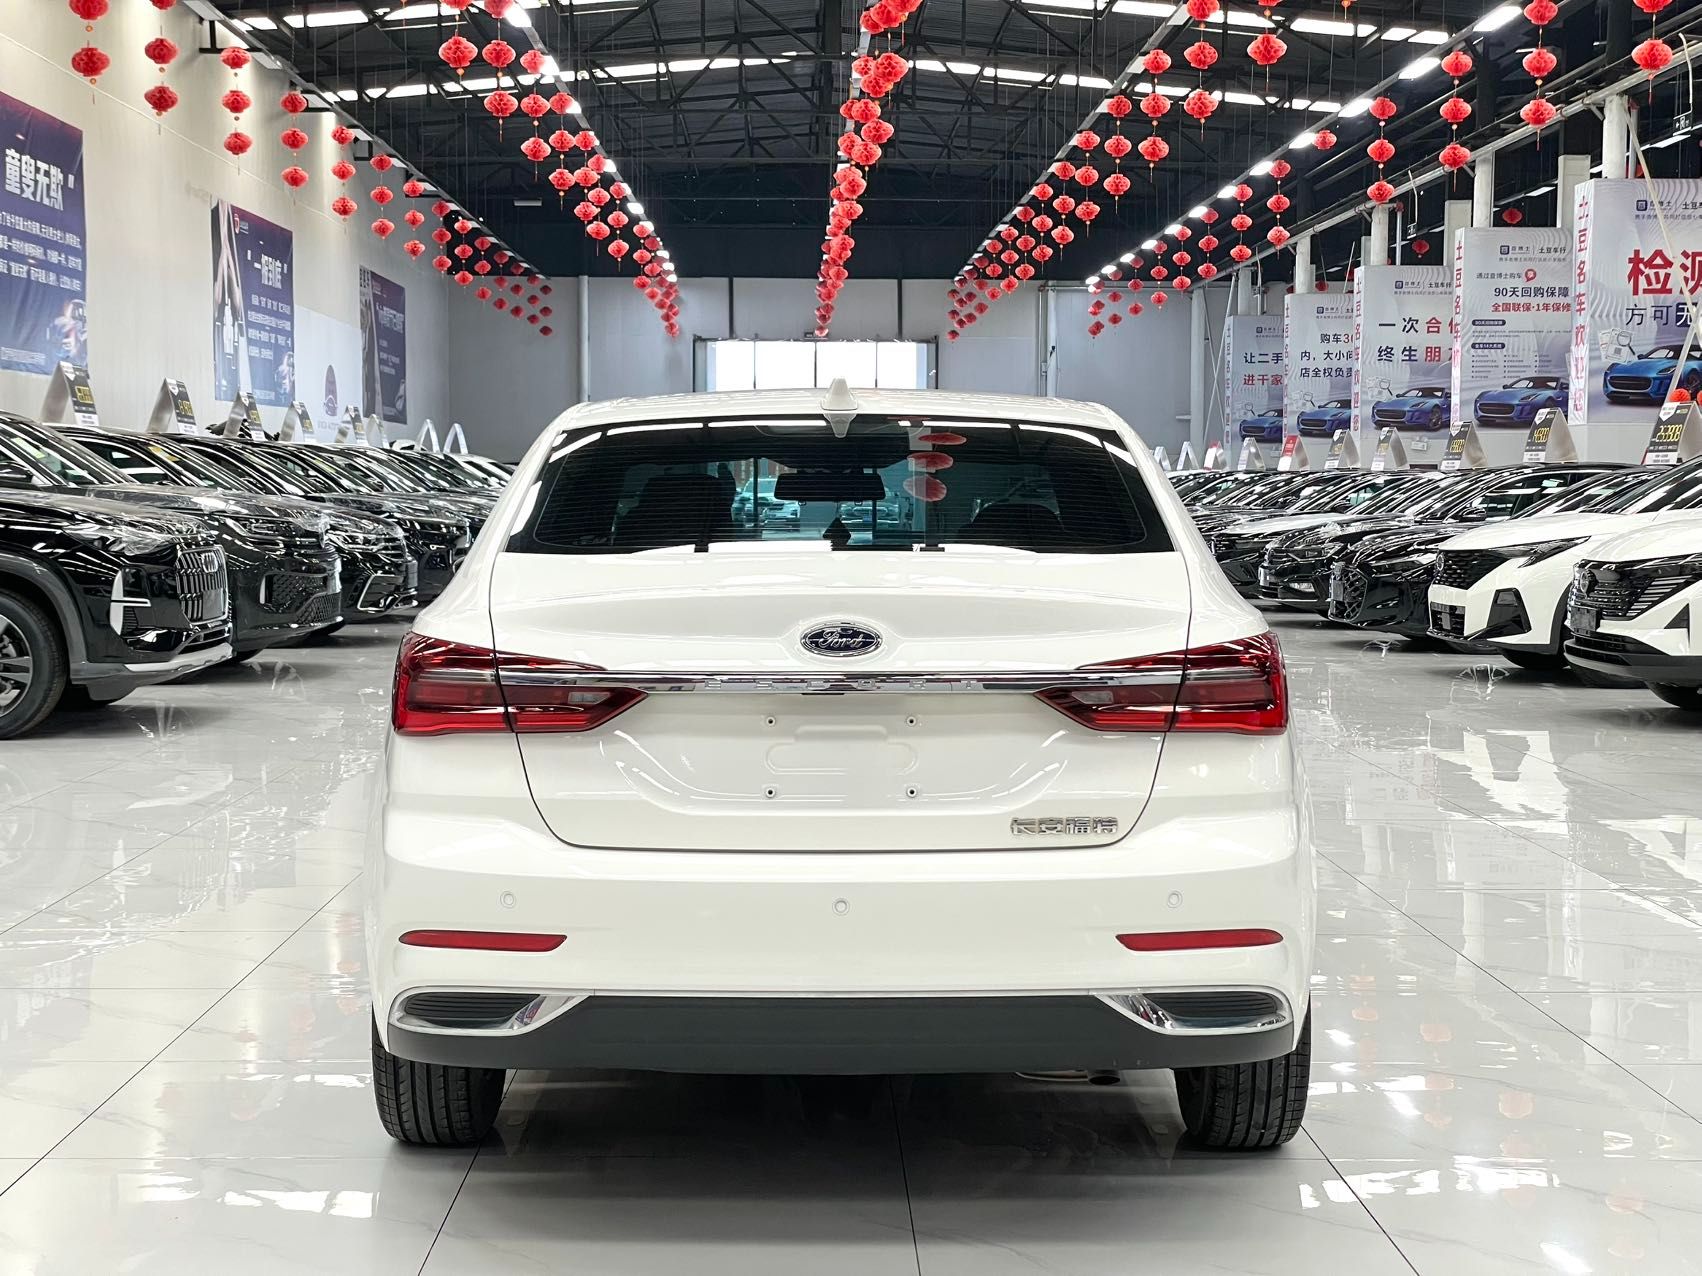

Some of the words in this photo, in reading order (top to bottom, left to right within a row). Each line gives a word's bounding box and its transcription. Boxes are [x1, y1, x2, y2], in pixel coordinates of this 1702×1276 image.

[1494, 286, 1570, 298] 90天回购保障
[1491, 302, 1572, 313] 全国联保·1年保修
[1574, 195, 1588, 412] 土豆名车欢迎您
[1320, 333, 1354, 344] 购车3
[1377, 345, 1453, 362] 终生朋
[818, 628, 864, 649] Ford
[1010, 817, 1118, 835] 长安福特
